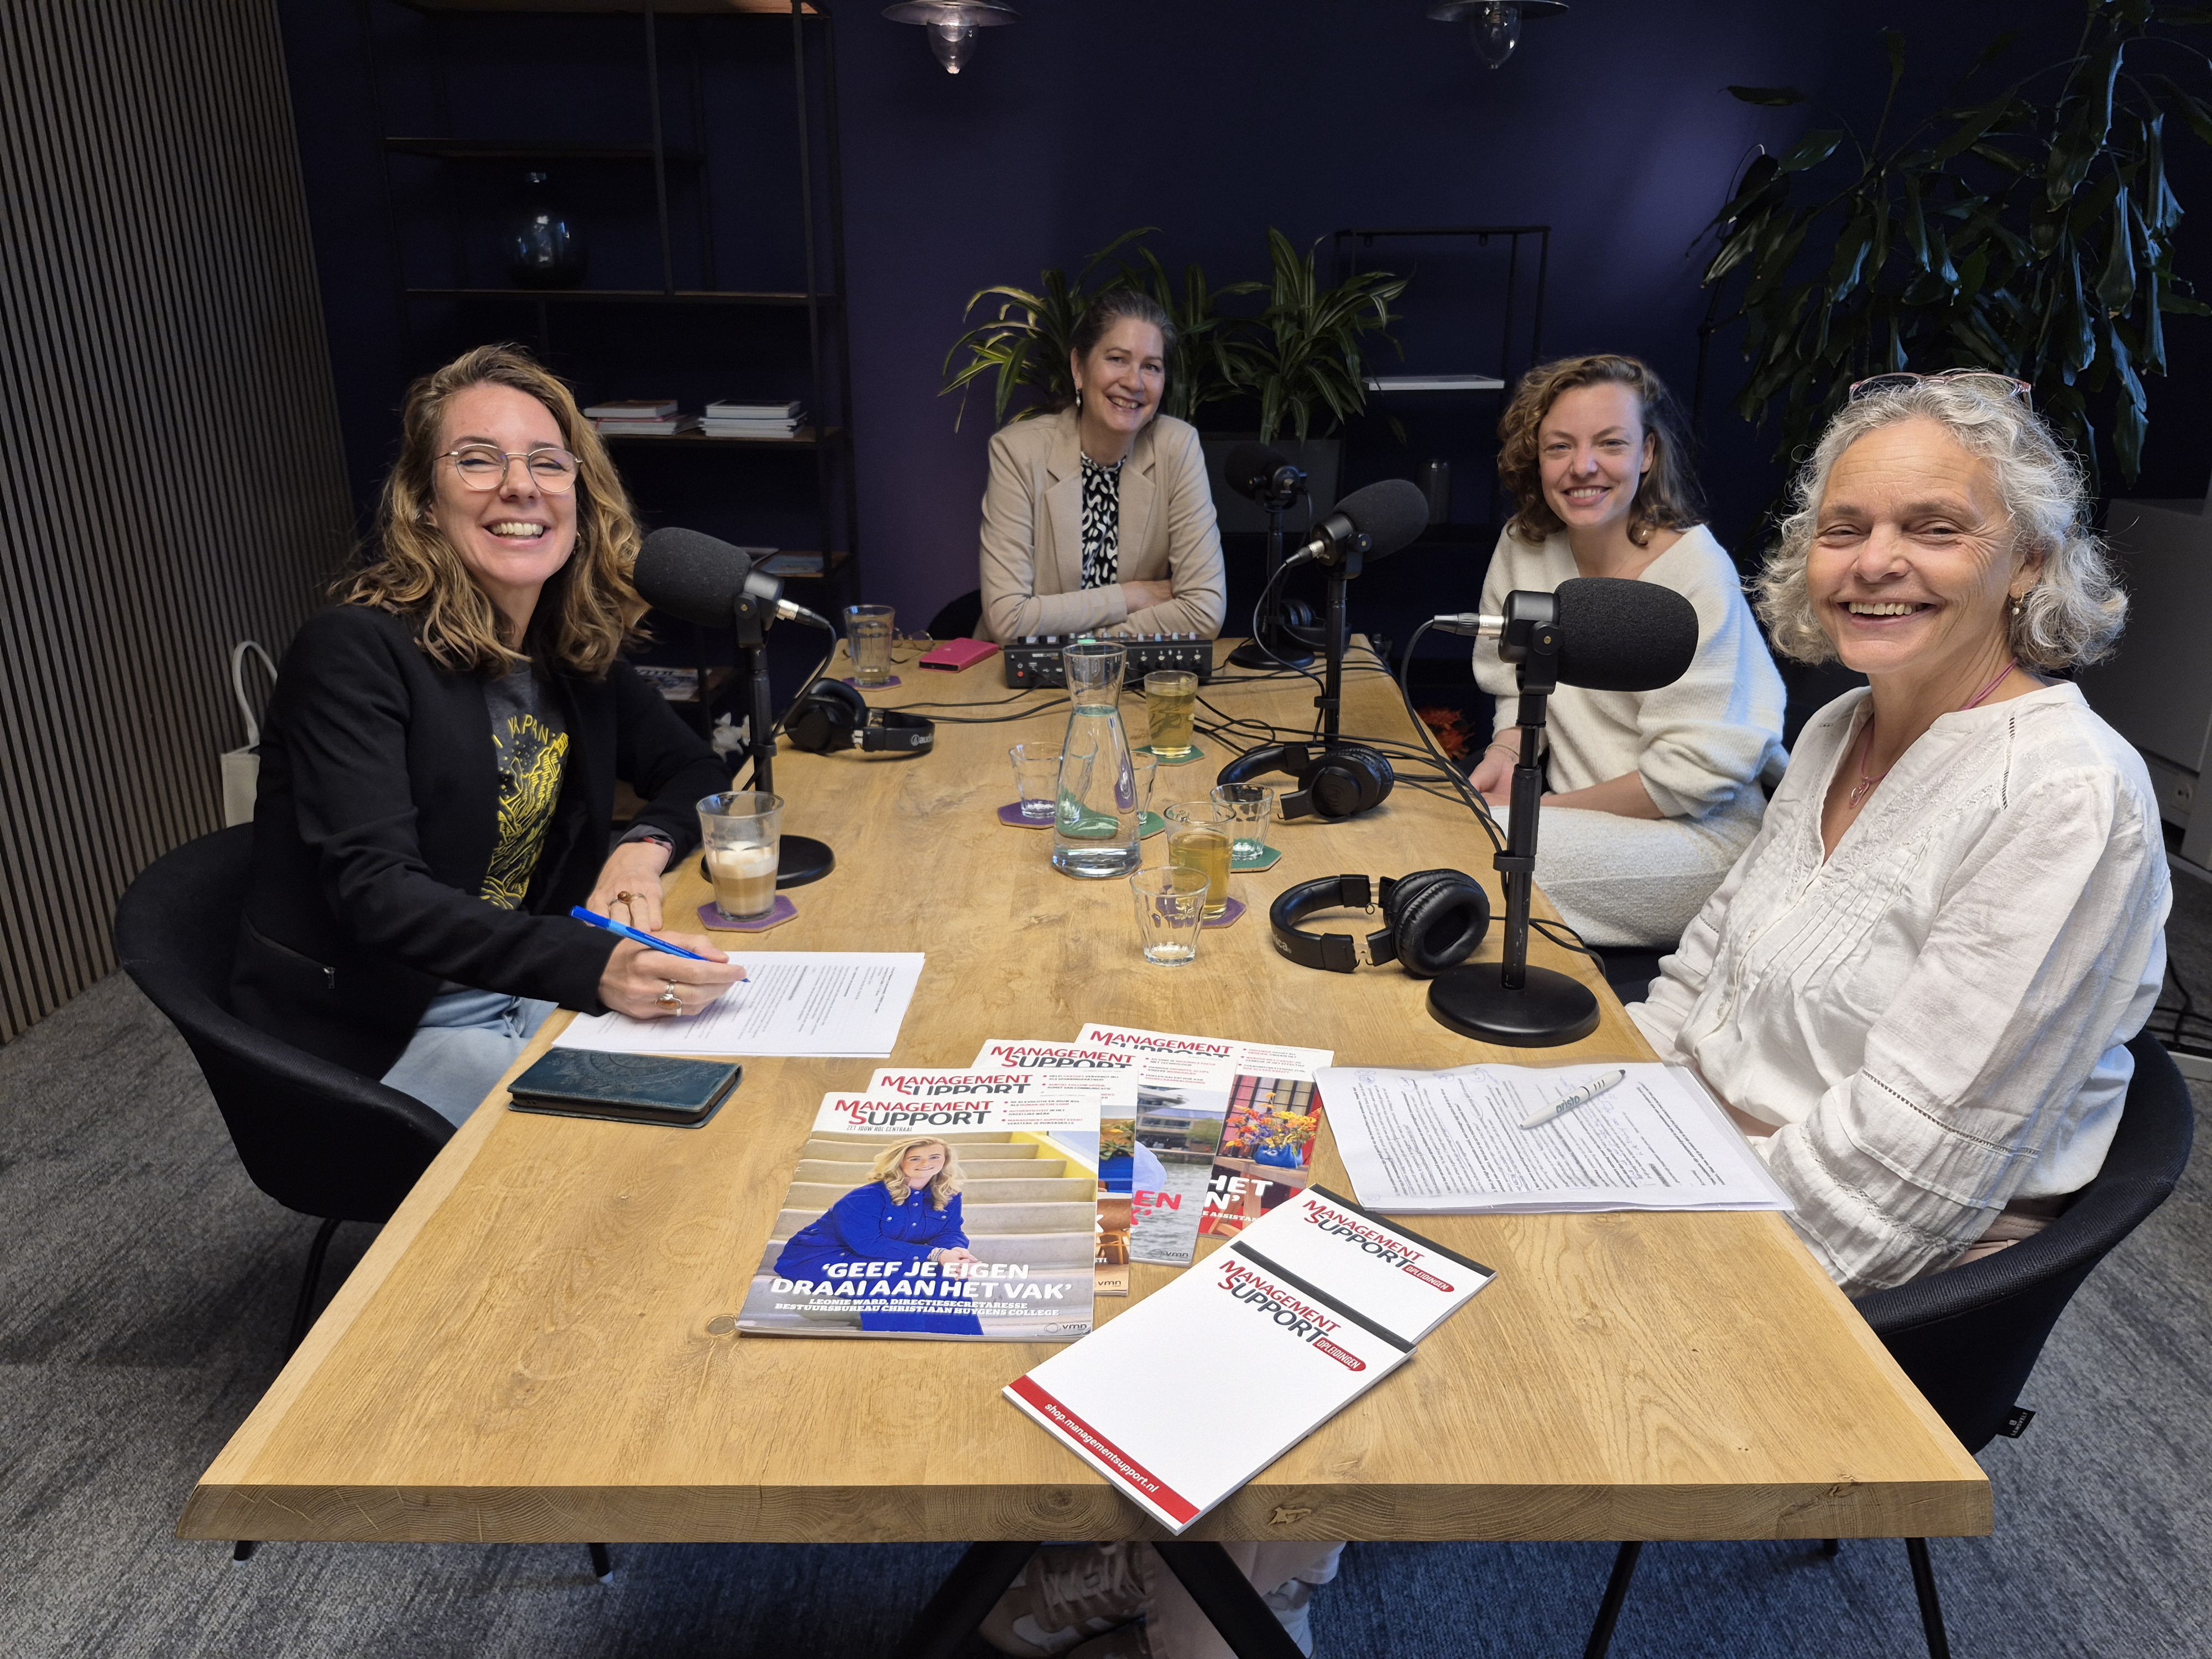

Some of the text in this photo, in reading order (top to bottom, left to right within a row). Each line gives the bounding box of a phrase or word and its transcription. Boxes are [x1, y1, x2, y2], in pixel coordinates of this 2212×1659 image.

[1090, 1030, 1234, 1054] MANAGEMENT
[990, 1046, 1136, 1063] MANAGEMENT
[881, 1074, 1033, 1087] MANAGEMENT
[834, 1099, 994, 1112] MANAGEMENT
[1556, 1095, 1580, 1114] aristo
[848, 1110, 992, 1126] SUPPORT
[1209, 1175, 1274, 1196] HET
[1302, 1199, 1425, 1261] MANAGEMENT
[1303, 1212, 1415, 1268] SUPPORT
[823, 1261, 1030, 1279] ‘GEEF JE EIGEN
[1405, 1265, 1449, 1290] OPLEIDINGEN
[770, 1278, 1072, 1299] DRAAI AAN HET VAK’
[1219, 1260, 1342, 1332] MANAGEMENT
[775, 1303, 880, 1311] BESTUURSBUREAU
[881, 1306, 952, 1314] CHRISTIAAN
[953, 1307, 1007, 1316] HUYGENS
[889, 1300, 1027, 1308] DIRECTIESECRETARESSE
[1218, 1277, 1329, 1343] SUPPORT
[1317, 1339, 1361, 1370] OPLEIDINGEN
[1045, 1403, 1160, 1493] shop.managementsupport.nl
